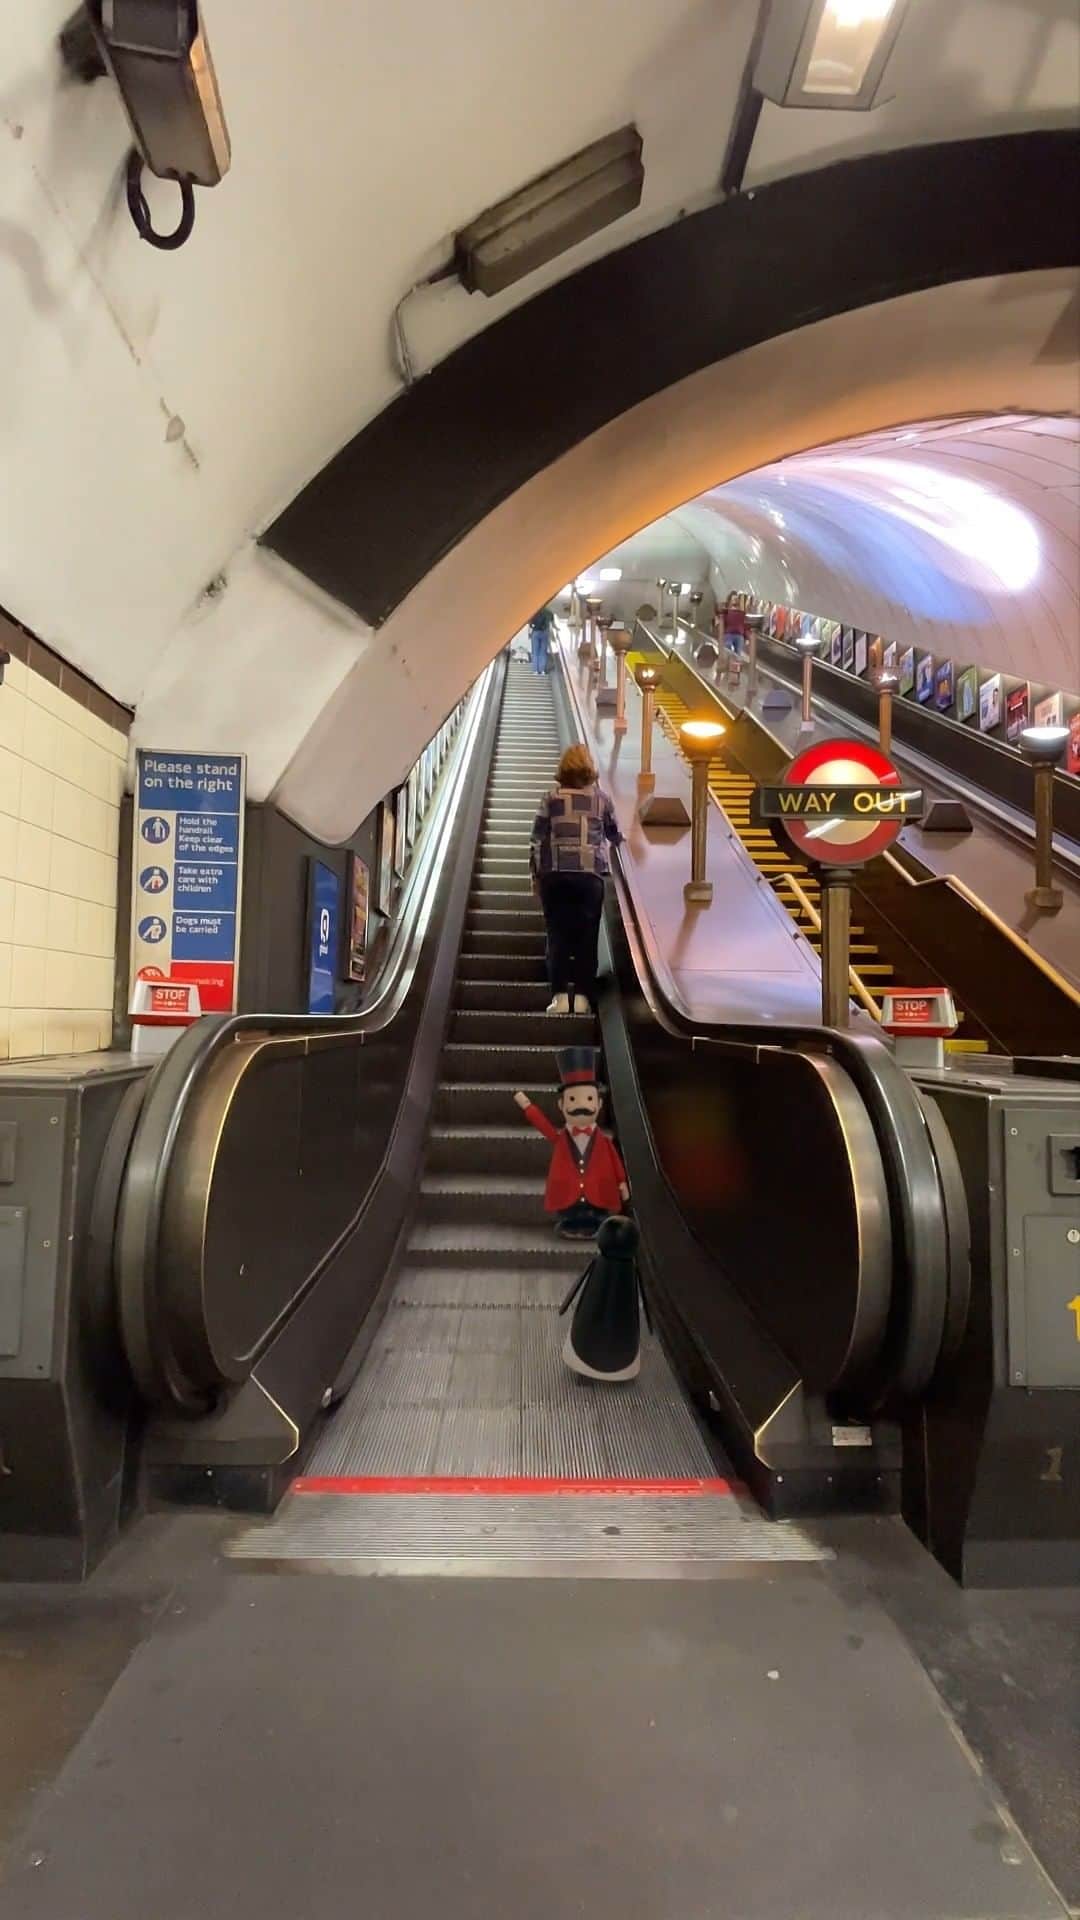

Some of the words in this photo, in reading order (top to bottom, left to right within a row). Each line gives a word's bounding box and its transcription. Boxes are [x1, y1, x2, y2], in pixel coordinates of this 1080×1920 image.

[144, 759, 192, 773] Please
[196, 763, 238, 776] stand
[144, 777, 162, 788] on
[168, 777, 193, 789] the
[198, 777, 233, 793] right
[778, 792, 837, 812] WAY
[853, 792, 911, 813] OUT
[179, 817, 200, 825] Hold
[202, 818, 218, 826] the
[179, 835, 200, 843] Keep
[191, 844, 206, 852] the
[208, 845, 234, 854] edges
[179, 866, 198, 874] Take
[177, 884, 212, 893] children
[176, 916, 199, 926] Dogs
[200, 918, 222, 926] must
[176, 925, 187, 933] be
[189, 926, 218, 934] carried
[156, 989, 186, 1001] STOP
[895, 1000, 927, 1011] STOP
[1040, 1447, 1063, 1481] 1
